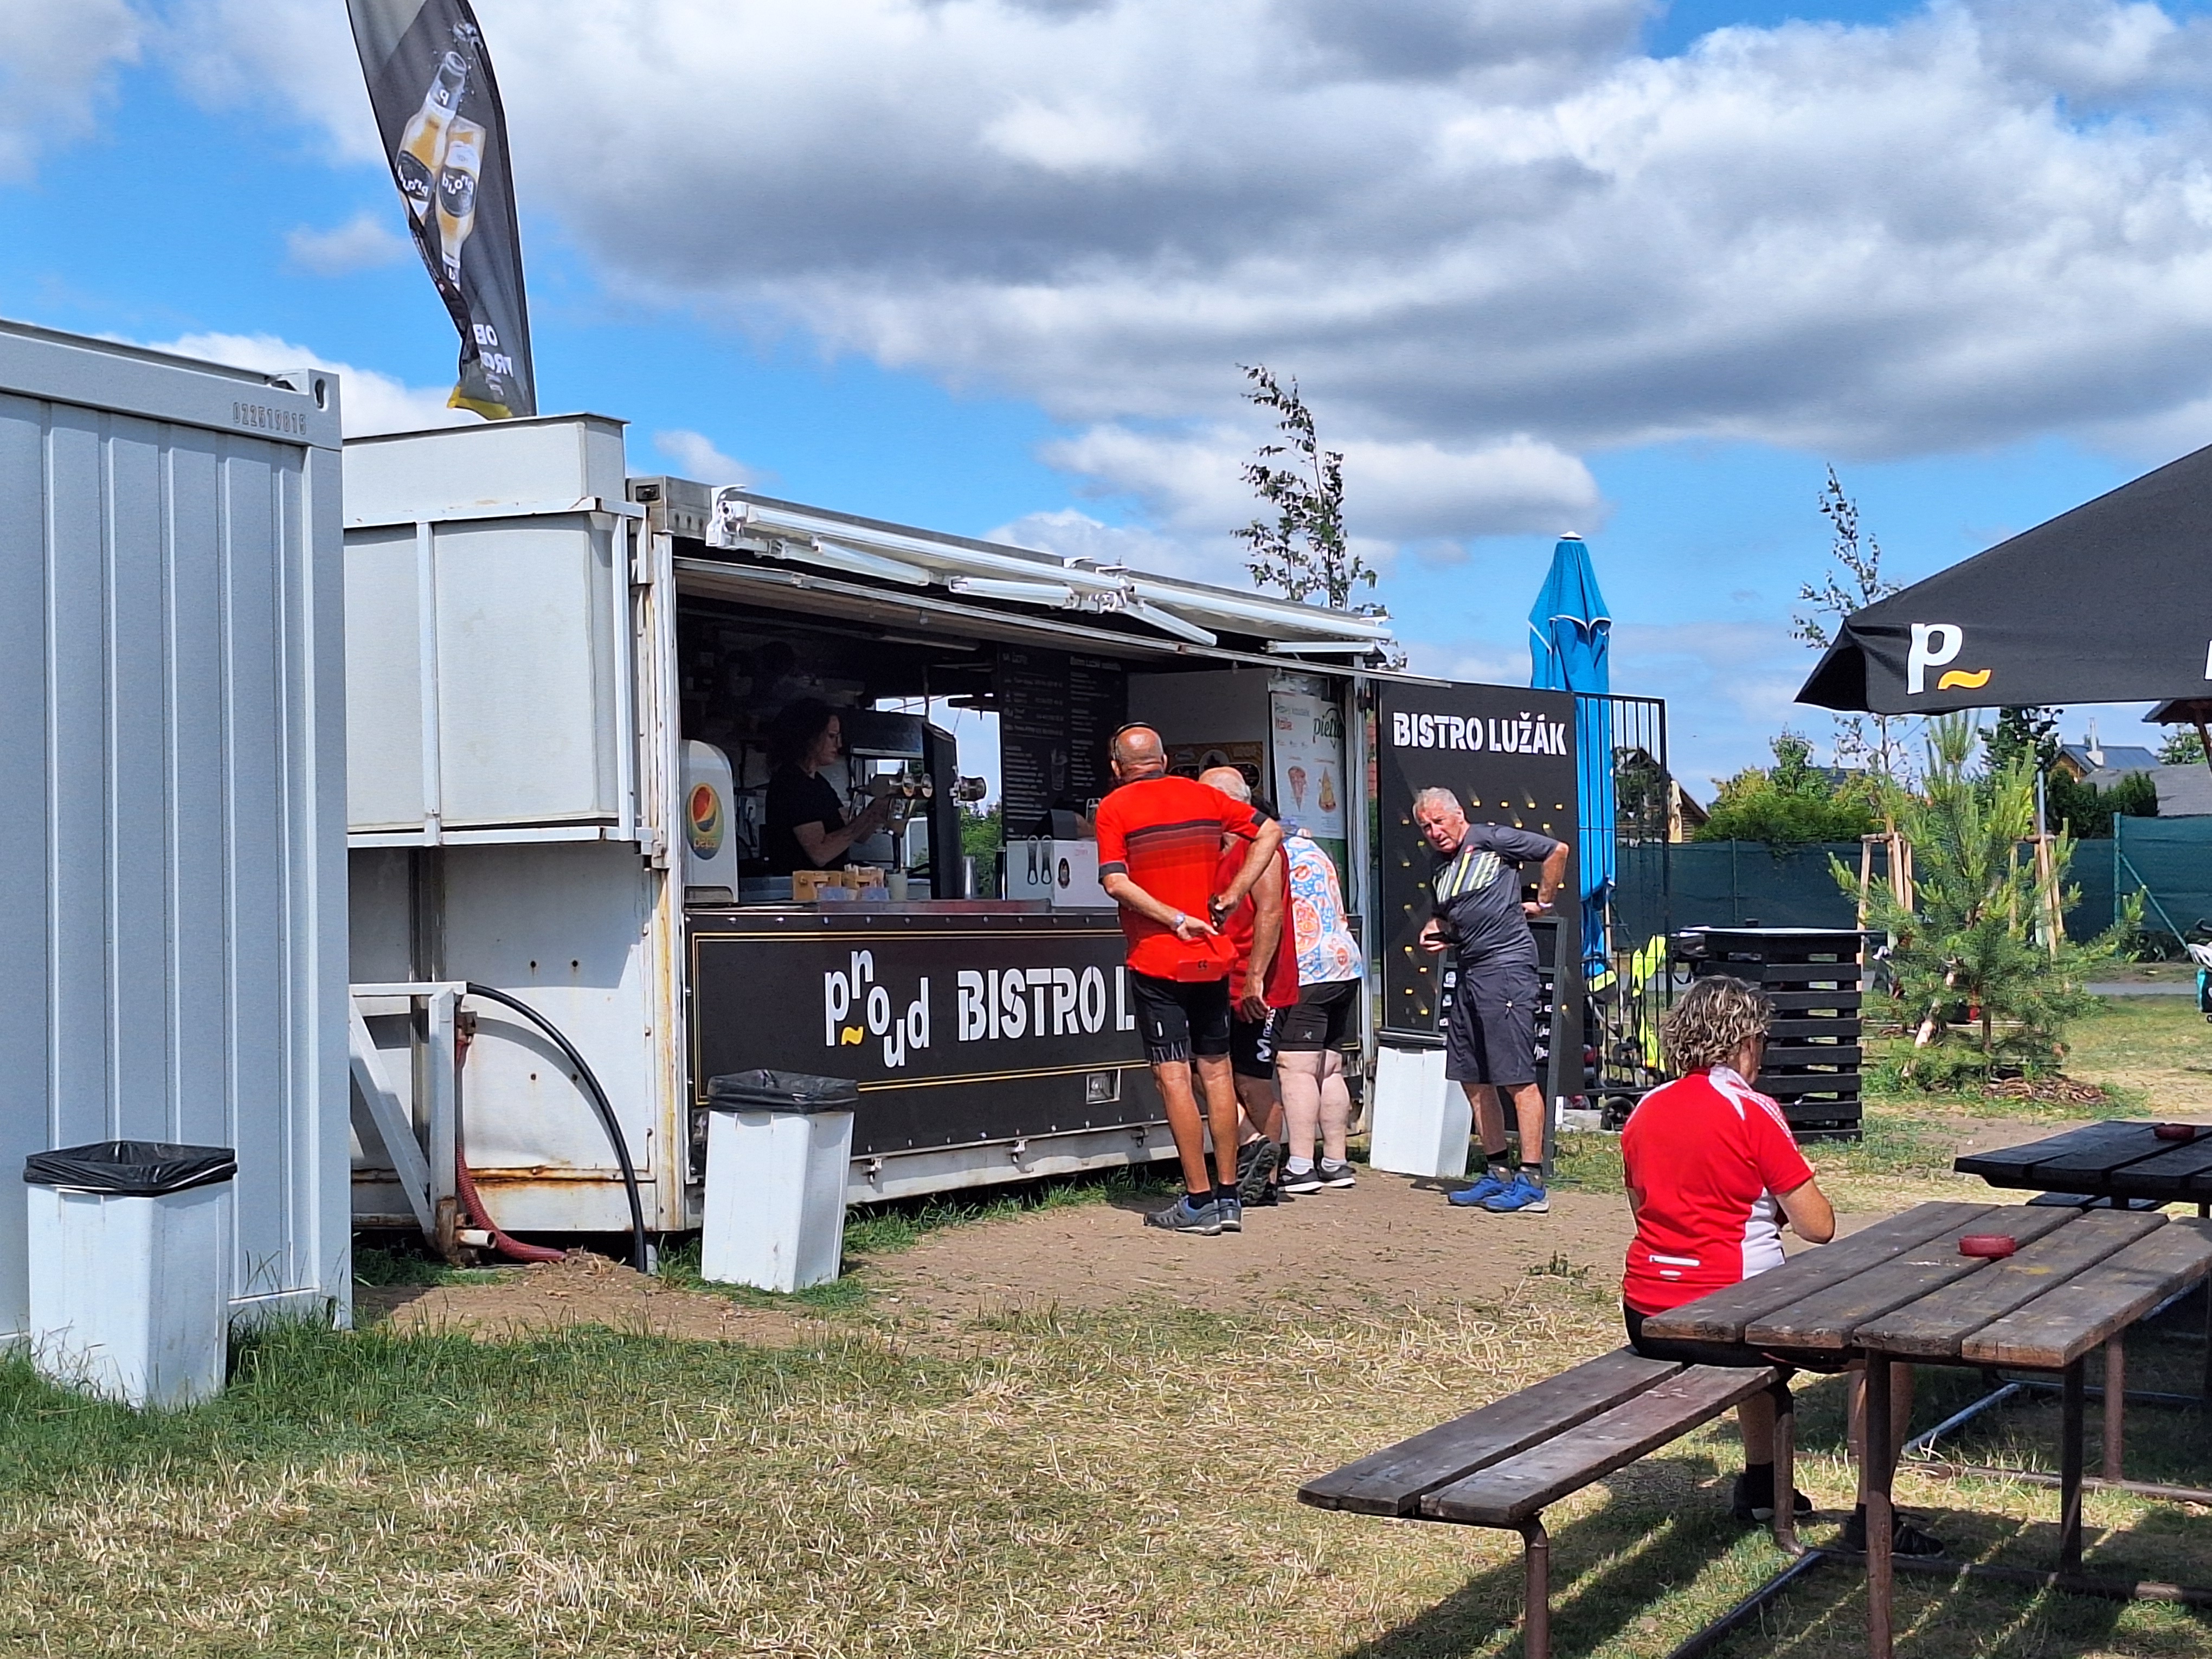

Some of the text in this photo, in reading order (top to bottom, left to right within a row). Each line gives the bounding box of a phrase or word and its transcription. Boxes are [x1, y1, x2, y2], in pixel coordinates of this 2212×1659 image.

[1393, 711, 1567, 756] BISTRO LUŽÁK
[825, 949, 930, 1068] proud
[957, 966, 1106, 1041] BISTRO
